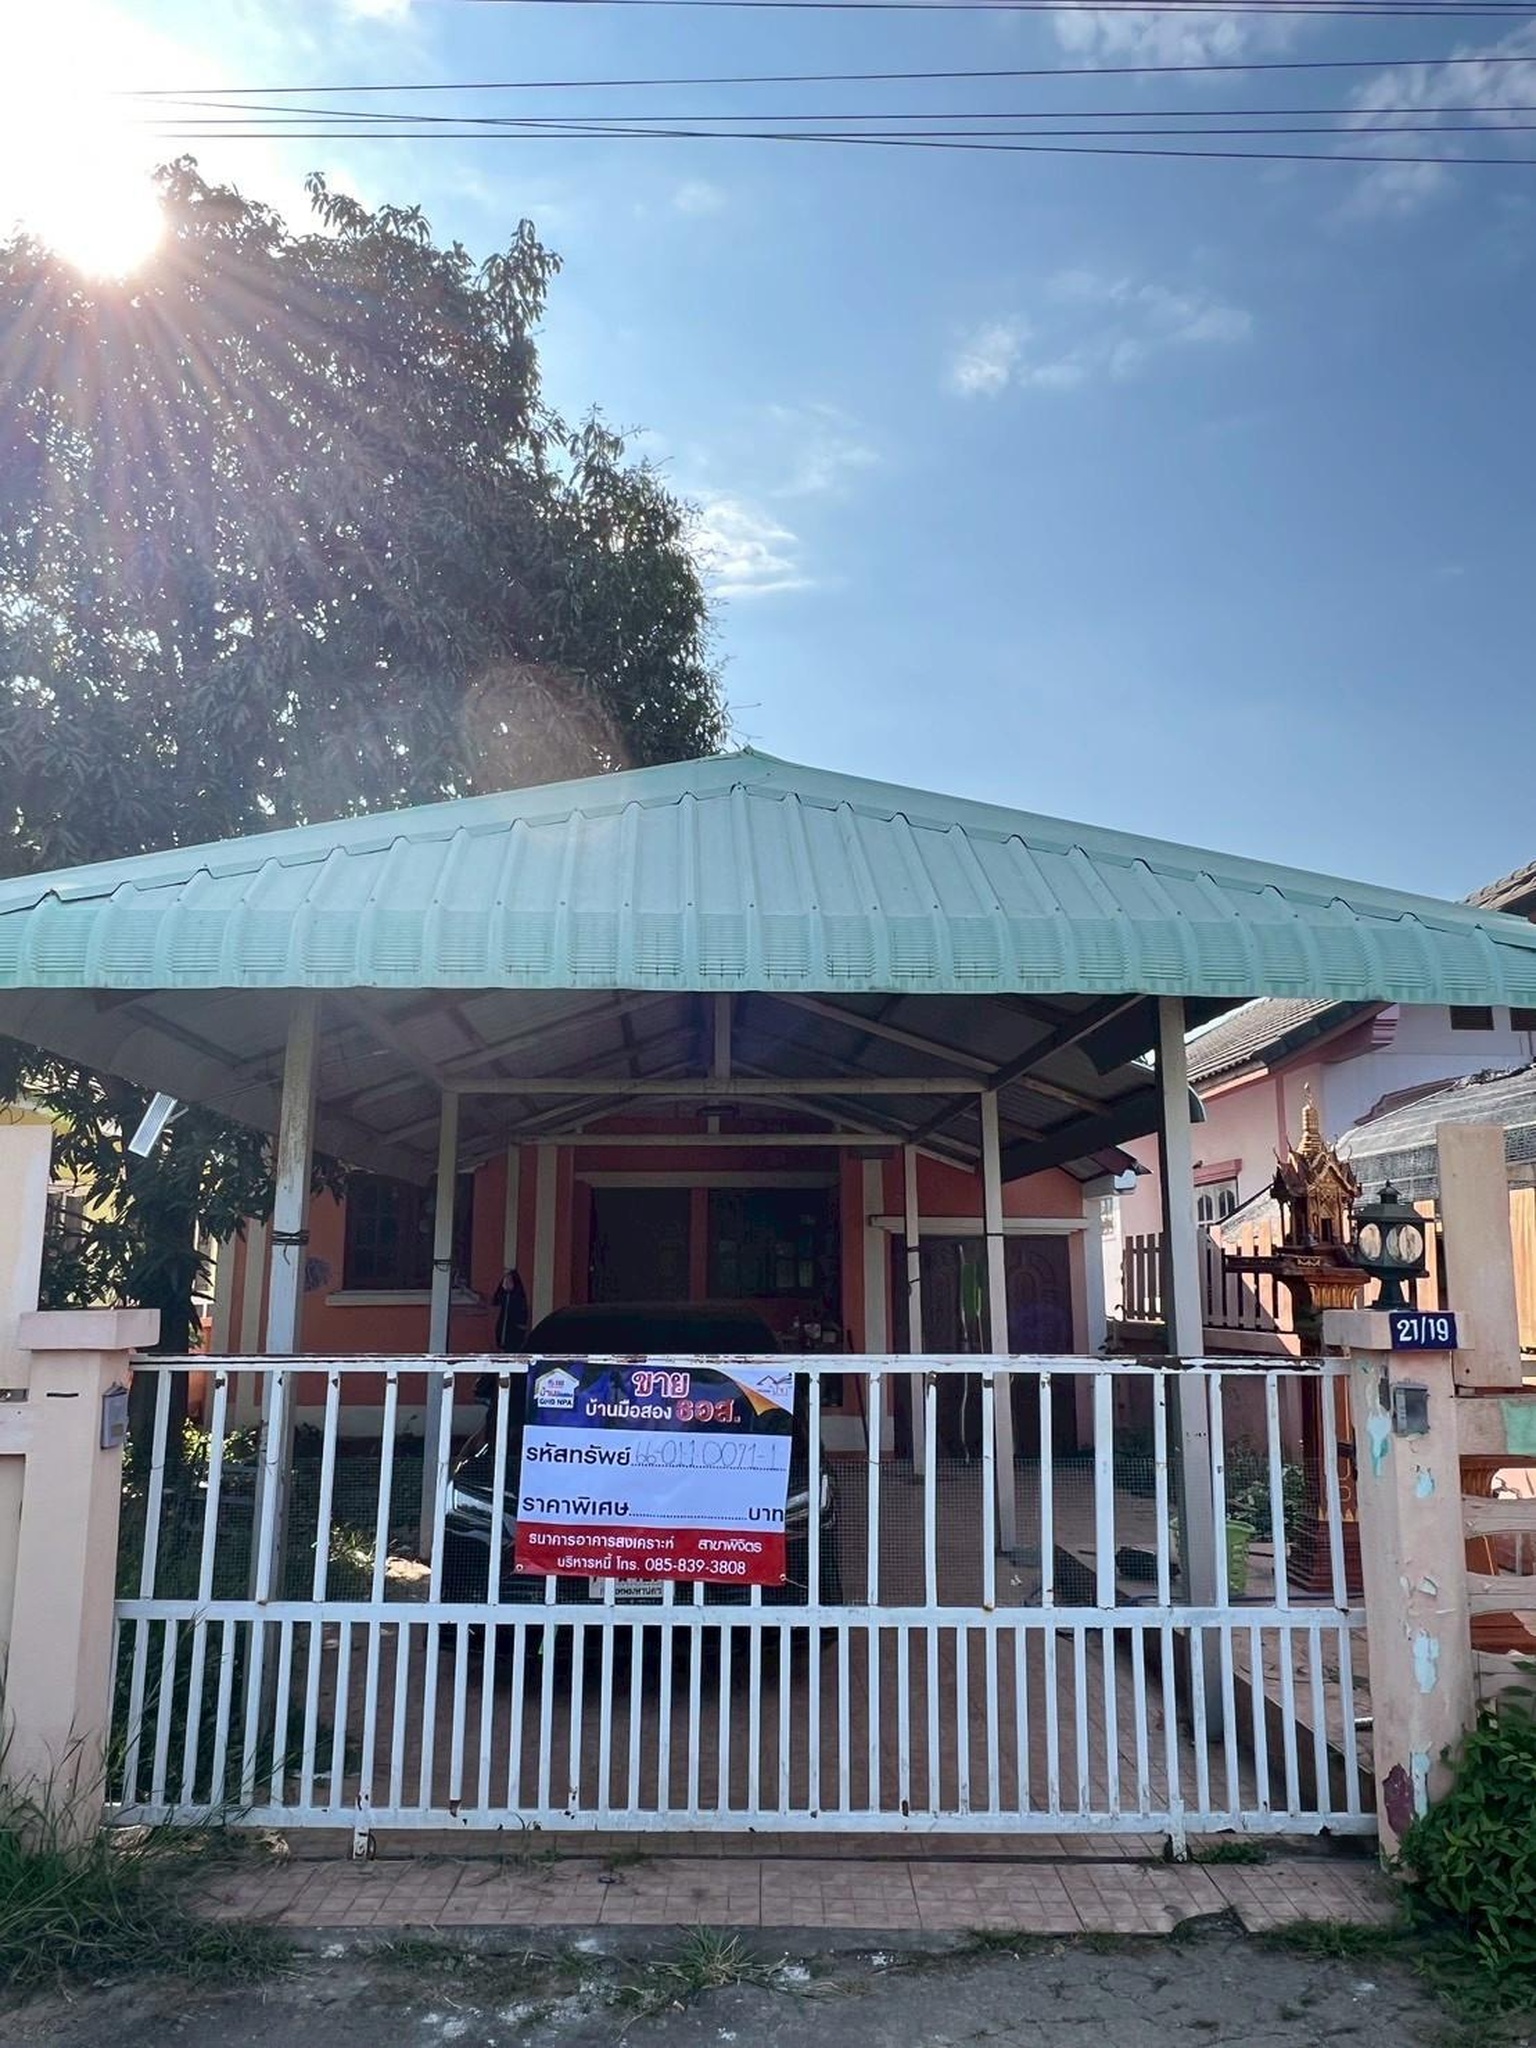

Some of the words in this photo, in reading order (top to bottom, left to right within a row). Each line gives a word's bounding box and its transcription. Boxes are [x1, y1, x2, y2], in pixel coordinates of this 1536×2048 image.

[1397, 1316, 1449, 1344] 21/19
[632, 1371, 690, 1398] ขาย
[586, 1398, 672, 1419] บ้านมือสอง
[526, 1442, 631, 1466] รหัสทรัพย์
[522, 1496, 629, 1516] ราคาพิเศษ
[749, 1507, 783, 1522] บาท
[528, 1532, 674, 1550] ธนาคารอาคารสงเคราะห์
[557, 1553, 612, 1571] บริหารหนี้
[616, 1556, 640, 1571] โทร.
[645, 1557, 746, 1575] 085-839-3808
